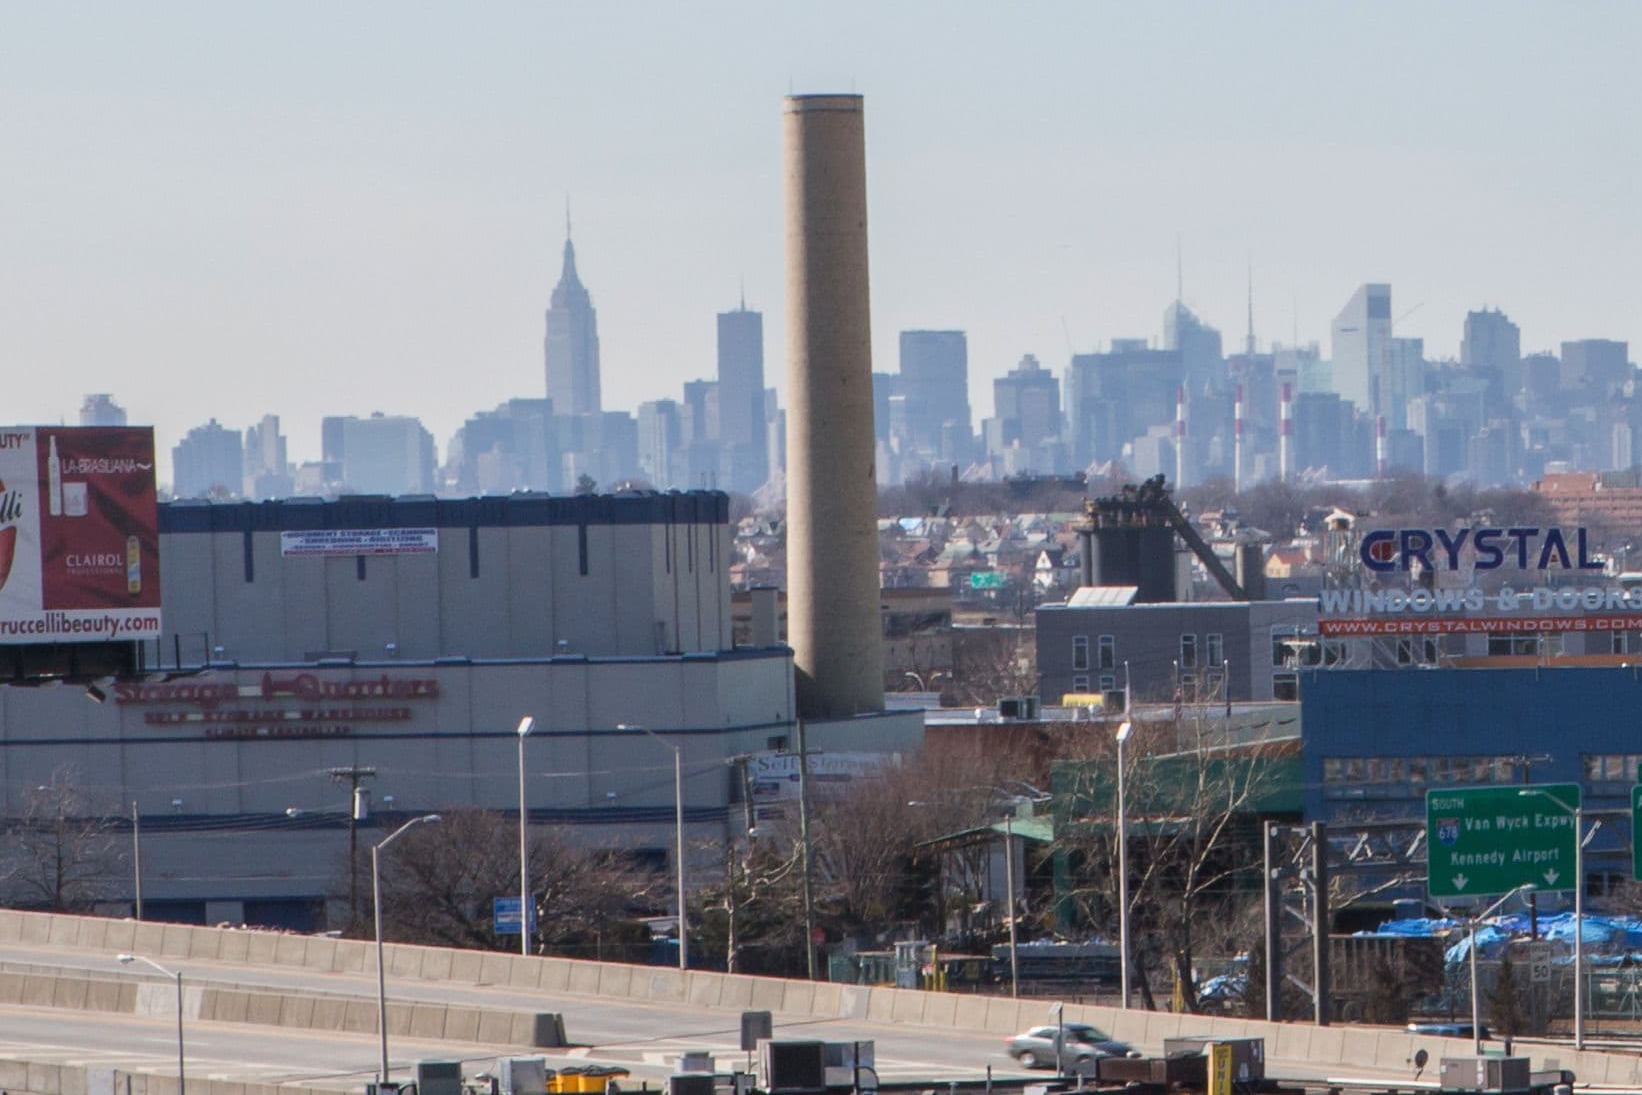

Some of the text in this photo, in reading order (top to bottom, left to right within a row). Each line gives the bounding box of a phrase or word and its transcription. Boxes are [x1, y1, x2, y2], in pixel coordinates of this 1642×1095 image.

[1359, 526, 1606, 572] CRYSTAL
[66, 554, 124, 568] CLAIROL
[1319, 587, 1485, 614] WINDOWS
[1498, 587, 1522, 611] &
[1432, 798, 1465, 811] SOUTH
[1464, 816, 1490, 831] Van
[1496, 815, 1529, 832] Wyck
[1535, 813, 1576, 829] Expwy
[1439, 826, 1459, 840] 678
[1451, 847, 1560, 868] Kennedy Airport
[1534, 965, 1549, 978] 50
